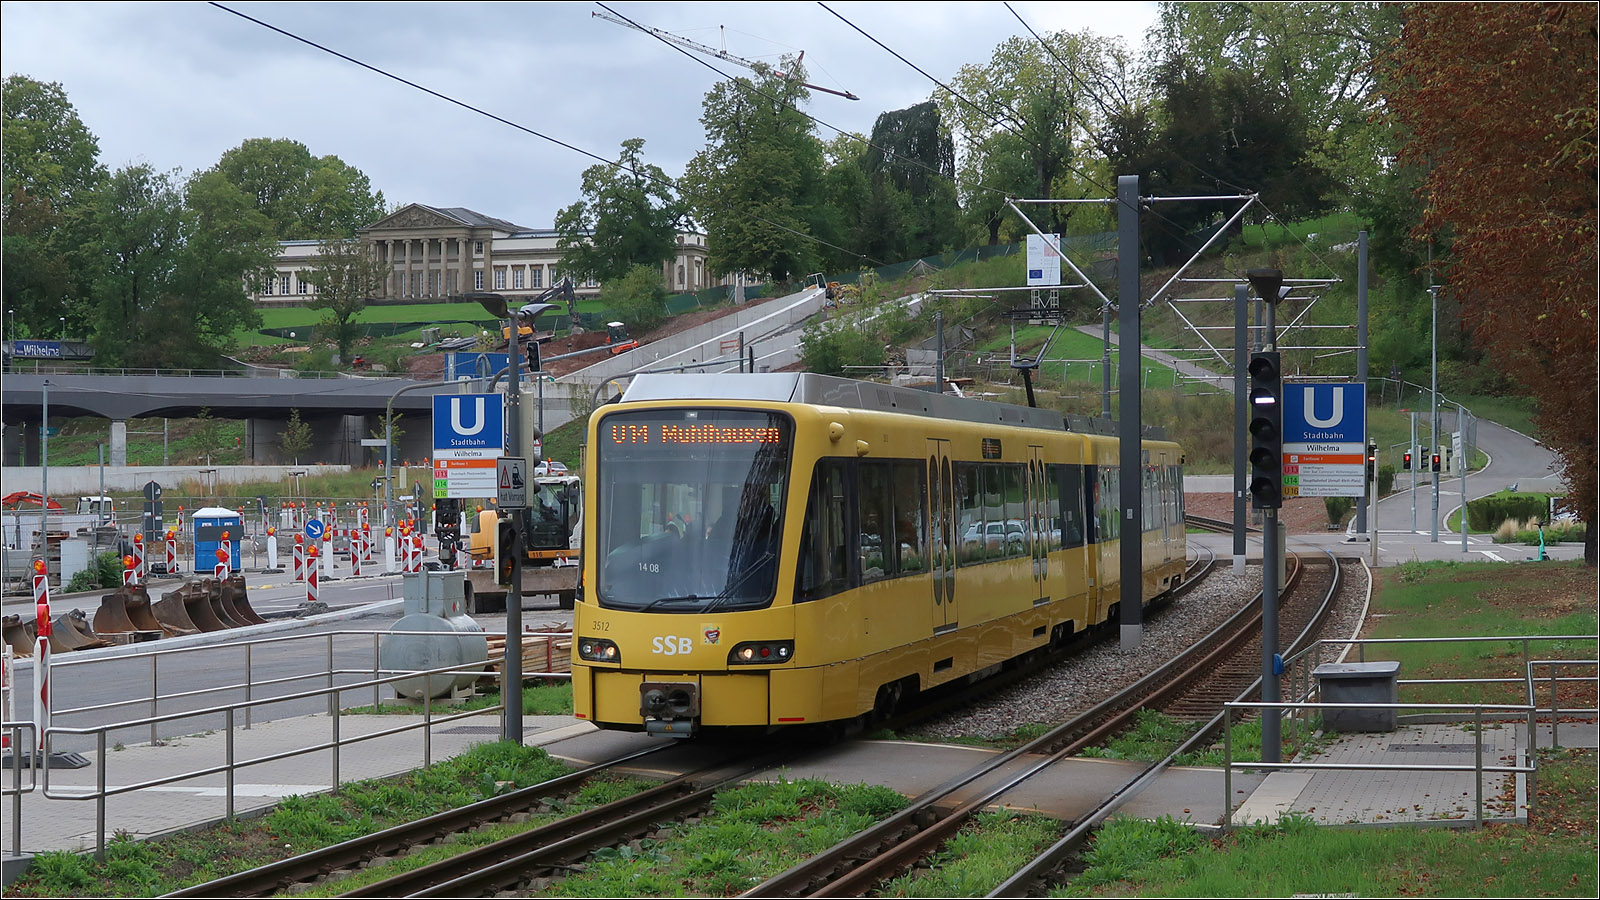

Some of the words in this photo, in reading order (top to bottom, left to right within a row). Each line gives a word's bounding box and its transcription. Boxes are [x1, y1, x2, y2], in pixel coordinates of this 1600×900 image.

[23, 344, 60, 357] Wilhelma
[1303, 387, 1344, 428] U
[450, 397, 485, 436] U
[1303, 431, 1344, 440] Stadtbahn
[450, 438, 486, 446] Stadtbahn
[1306, 444, 1340, 452] Wilhelma
[592, 620, 610, 632] 3512
[651, 635, 693, 656] SSB
